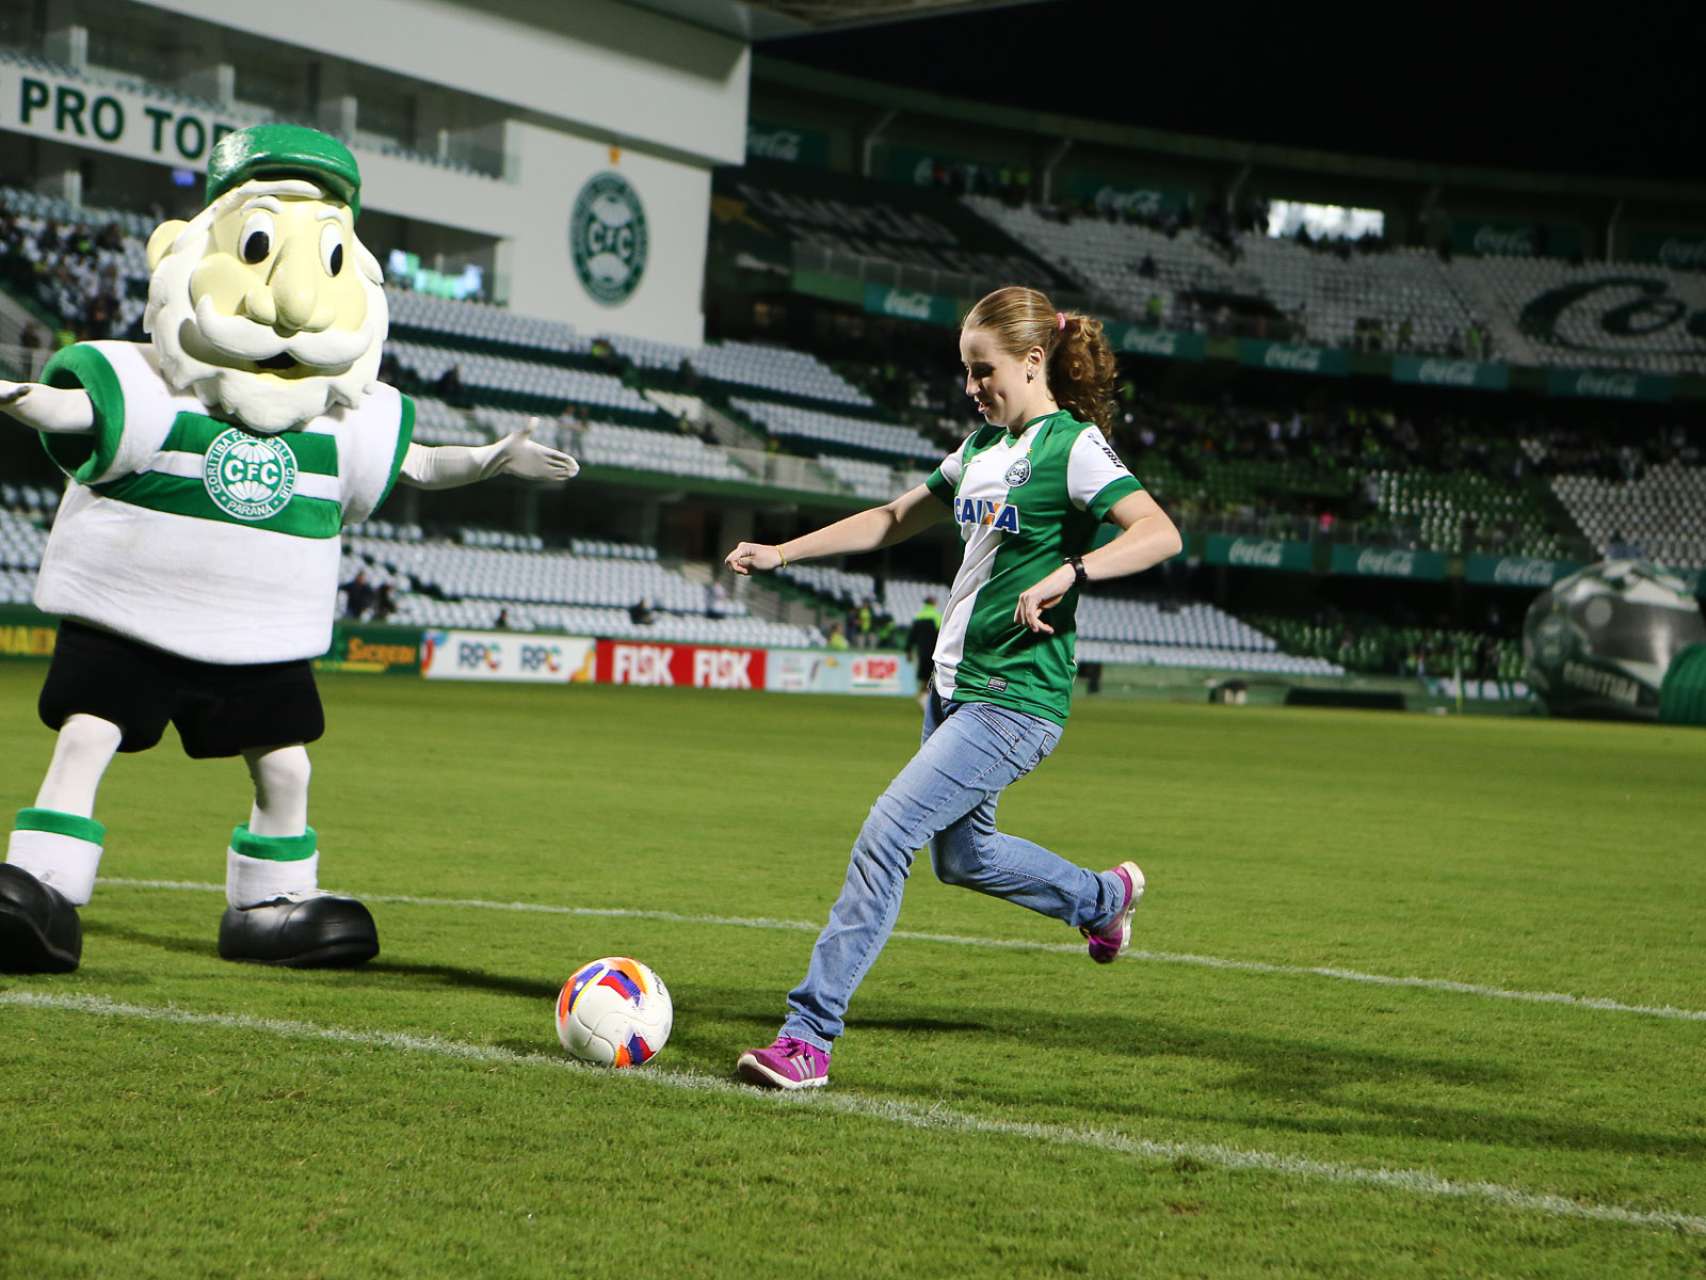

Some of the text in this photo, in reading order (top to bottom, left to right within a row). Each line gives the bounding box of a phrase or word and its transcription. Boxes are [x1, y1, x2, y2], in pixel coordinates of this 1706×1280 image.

[20, 77, 125, 141] PRO
[207, 436, 233, 495] CORITIBA
[223, 459, 280, 485] CFC
[954, 496, 1020, 535] CAIXA
[457, 641, 561, 673] RPC RPC
[612, 644, 674, 686] FISK
[693, 648, 752, 689] FISK
